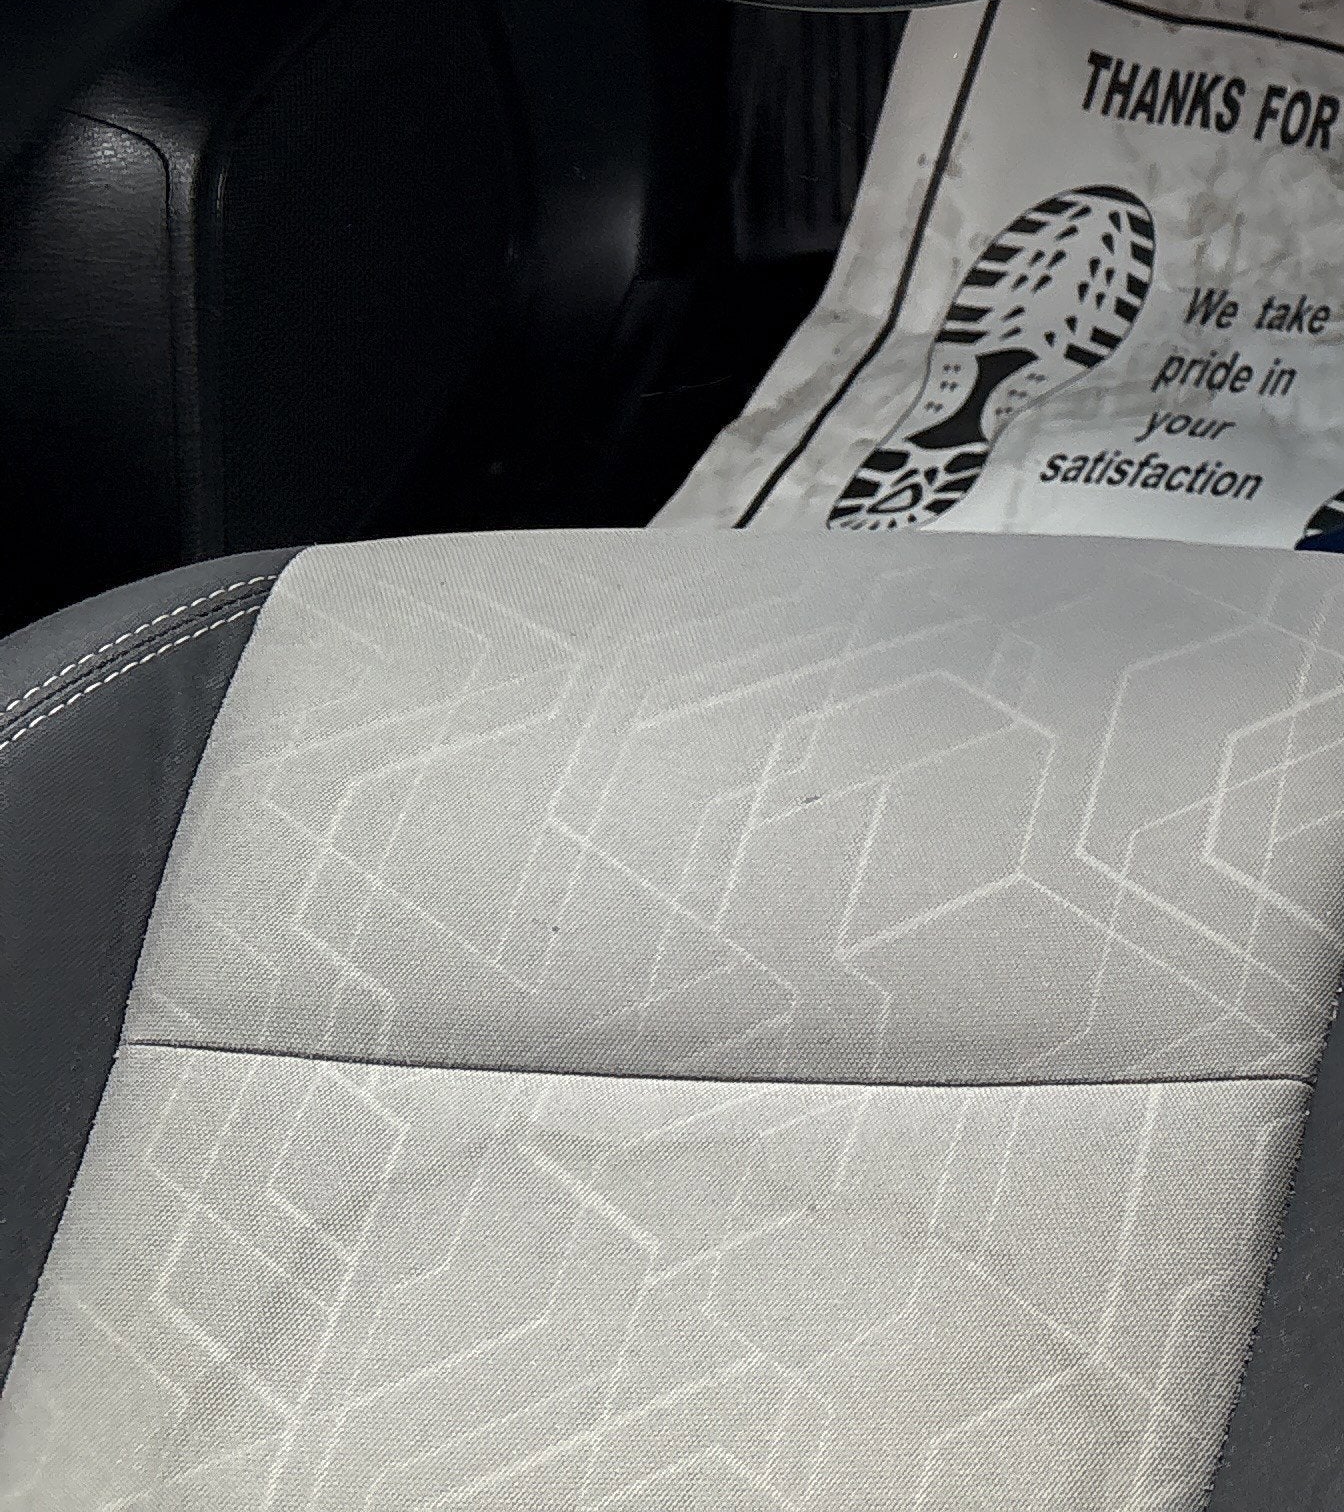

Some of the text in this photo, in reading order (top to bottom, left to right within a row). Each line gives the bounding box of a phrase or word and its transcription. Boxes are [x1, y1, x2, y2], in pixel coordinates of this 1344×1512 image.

[1082, 50, 1247, 134] THANKS
[1253, 84, 1341, 151] FOR
[1184, 287, 1330, 334] We take
[1151, 350, 1298, 395] pride in
[1134, 410, 1236, 443] your
[1039, 449, 1263, 500] satisfaction
